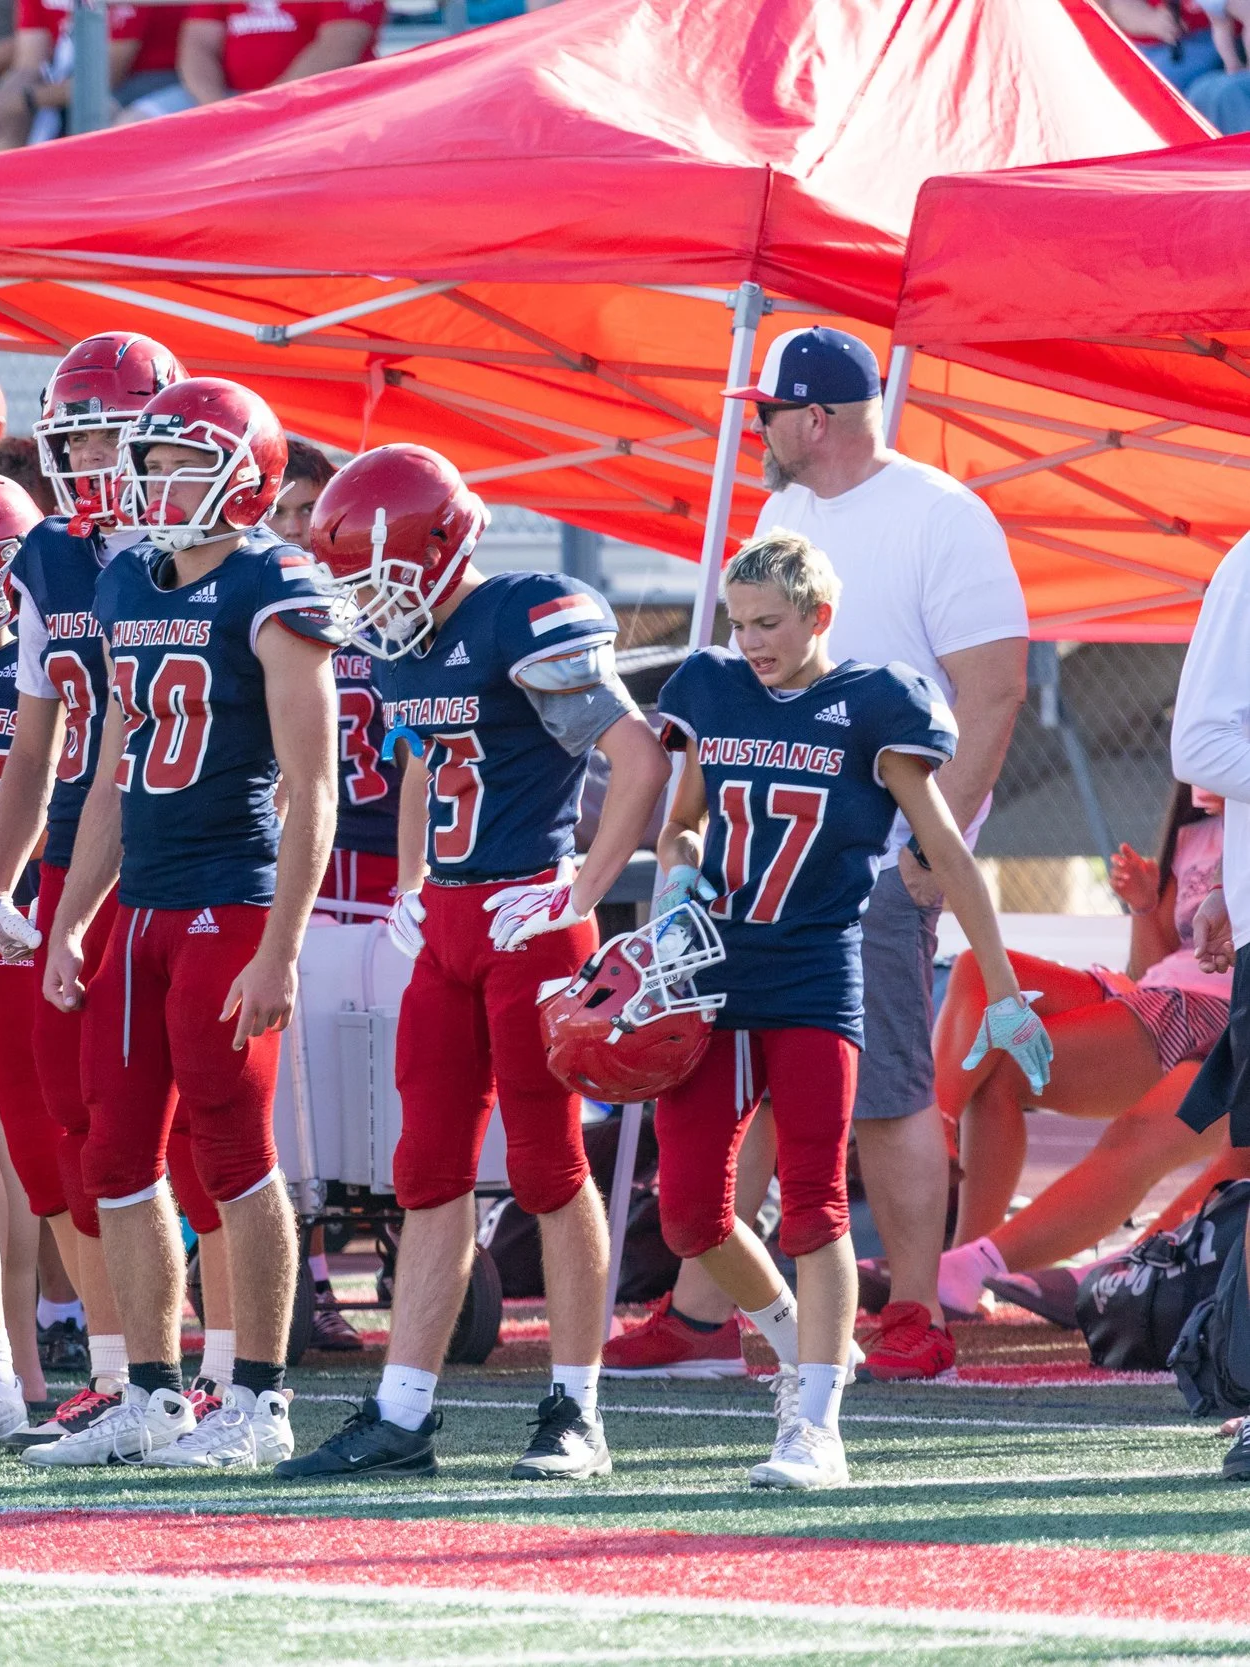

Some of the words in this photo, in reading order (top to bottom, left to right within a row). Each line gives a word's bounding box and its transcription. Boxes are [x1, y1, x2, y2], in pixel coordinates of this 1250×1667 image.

[188, 594, 218, 603] adidas
[111, 618, 213, 648] MUSTANGS
[444, 655, 471, 667] adidas
[814, 711, 851, 728] adidas
[699, 736, 845, 777] MUSTANGS
[708, 779, 830, 925] 17
[187, 923, 220, 935] adidas
